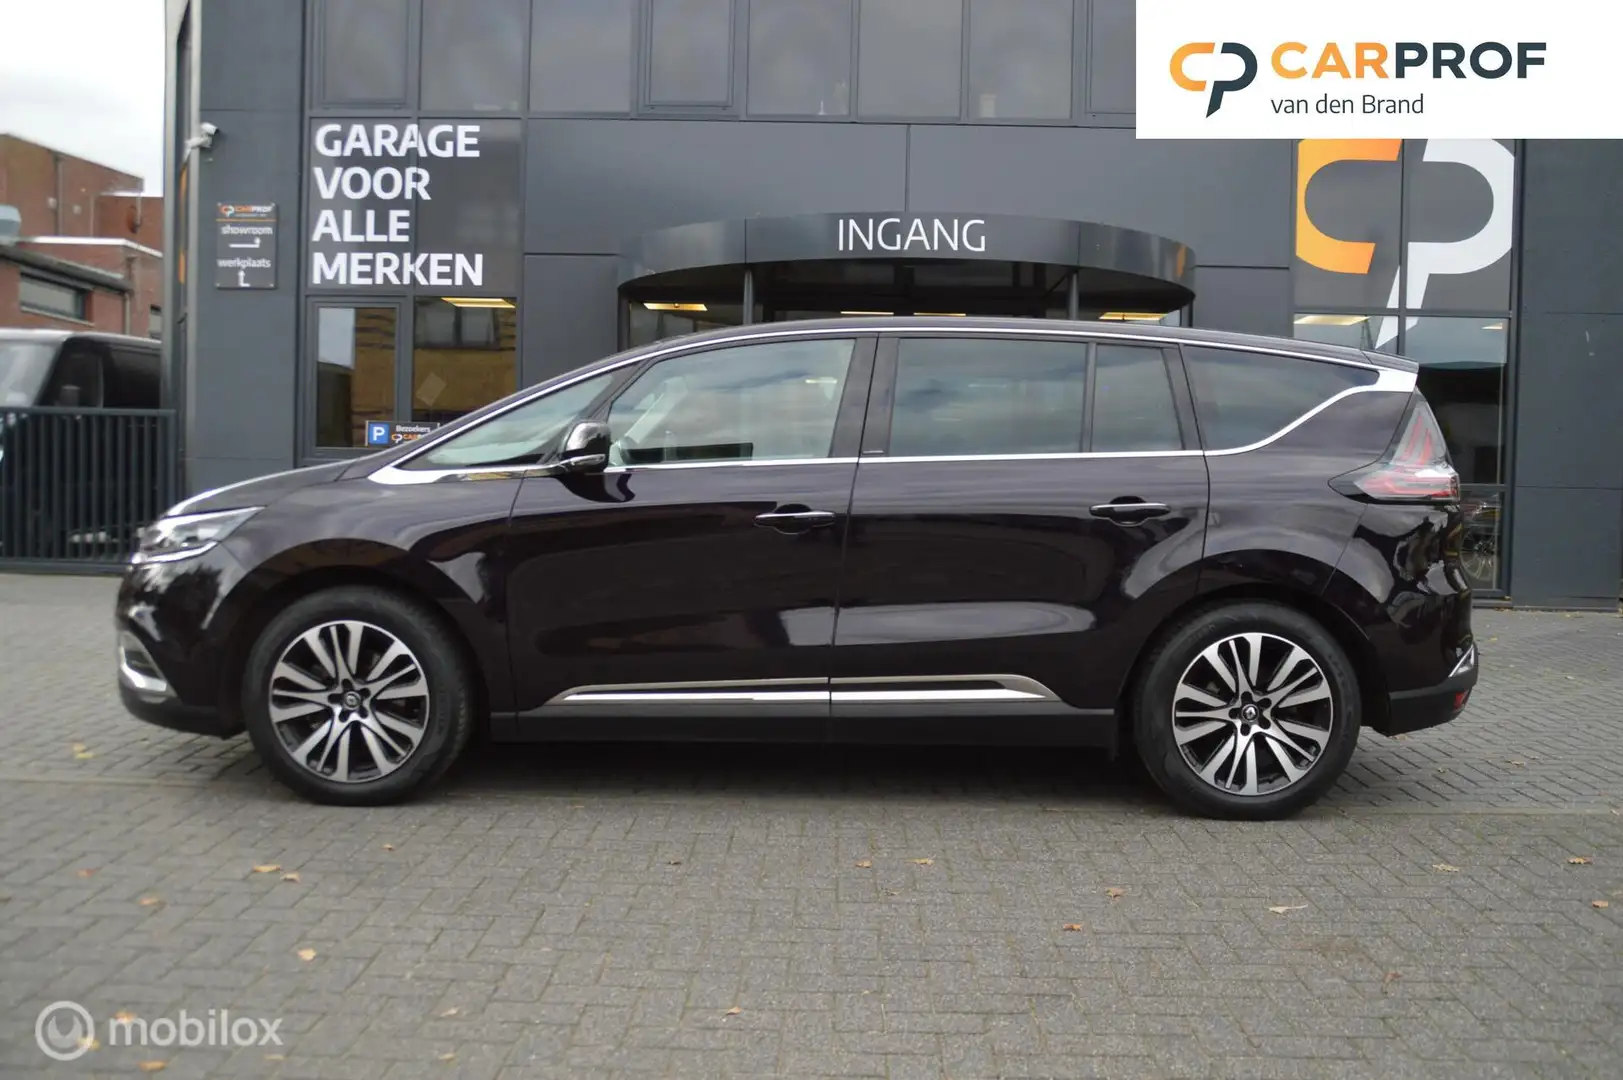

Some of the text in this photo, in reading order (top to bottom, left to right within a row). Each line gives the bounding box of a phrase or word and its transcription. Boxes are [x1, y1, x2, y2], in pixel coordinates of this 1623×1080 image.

[315, 123, 481, 157] GARAGE
[313, 166, 431, 200] VOOR
[221, 224, 273, 235] showroom
[312, 209, 410, 242] ALLE
[838, 218, 986, 252] INGANG
[217, 257, 272, 269] werkplaats
[312, 252, 484, 286] MERKEN
[372, 426, 386, 441] P
